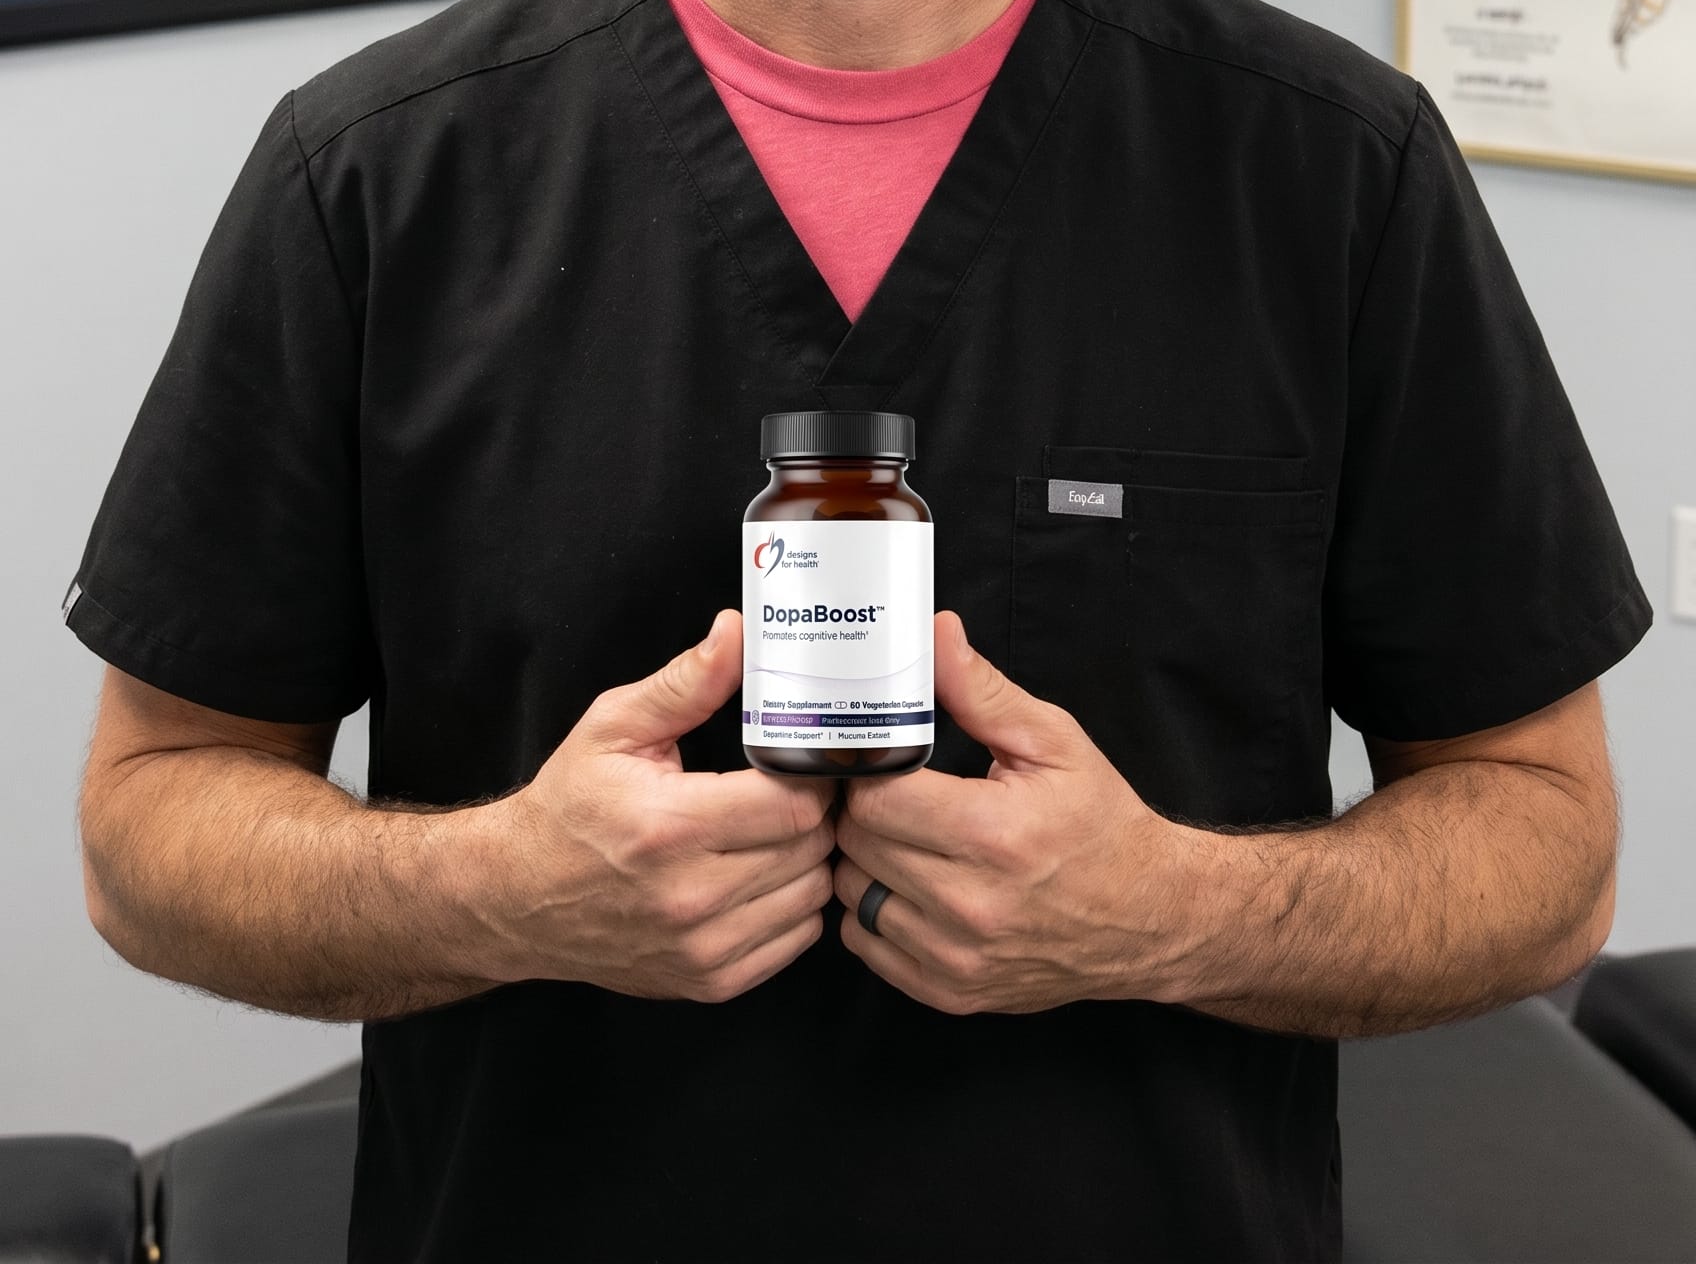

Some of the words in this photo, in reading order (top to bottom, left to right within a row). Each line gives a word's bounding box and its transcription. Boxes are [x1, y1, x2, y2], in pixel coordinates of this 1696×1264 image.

[786, 550, 818, 560] designs
[781, 560, 793, 568] for
[798, 630, 838, 642] cognitive
[850, 701, 861, 709] 60
